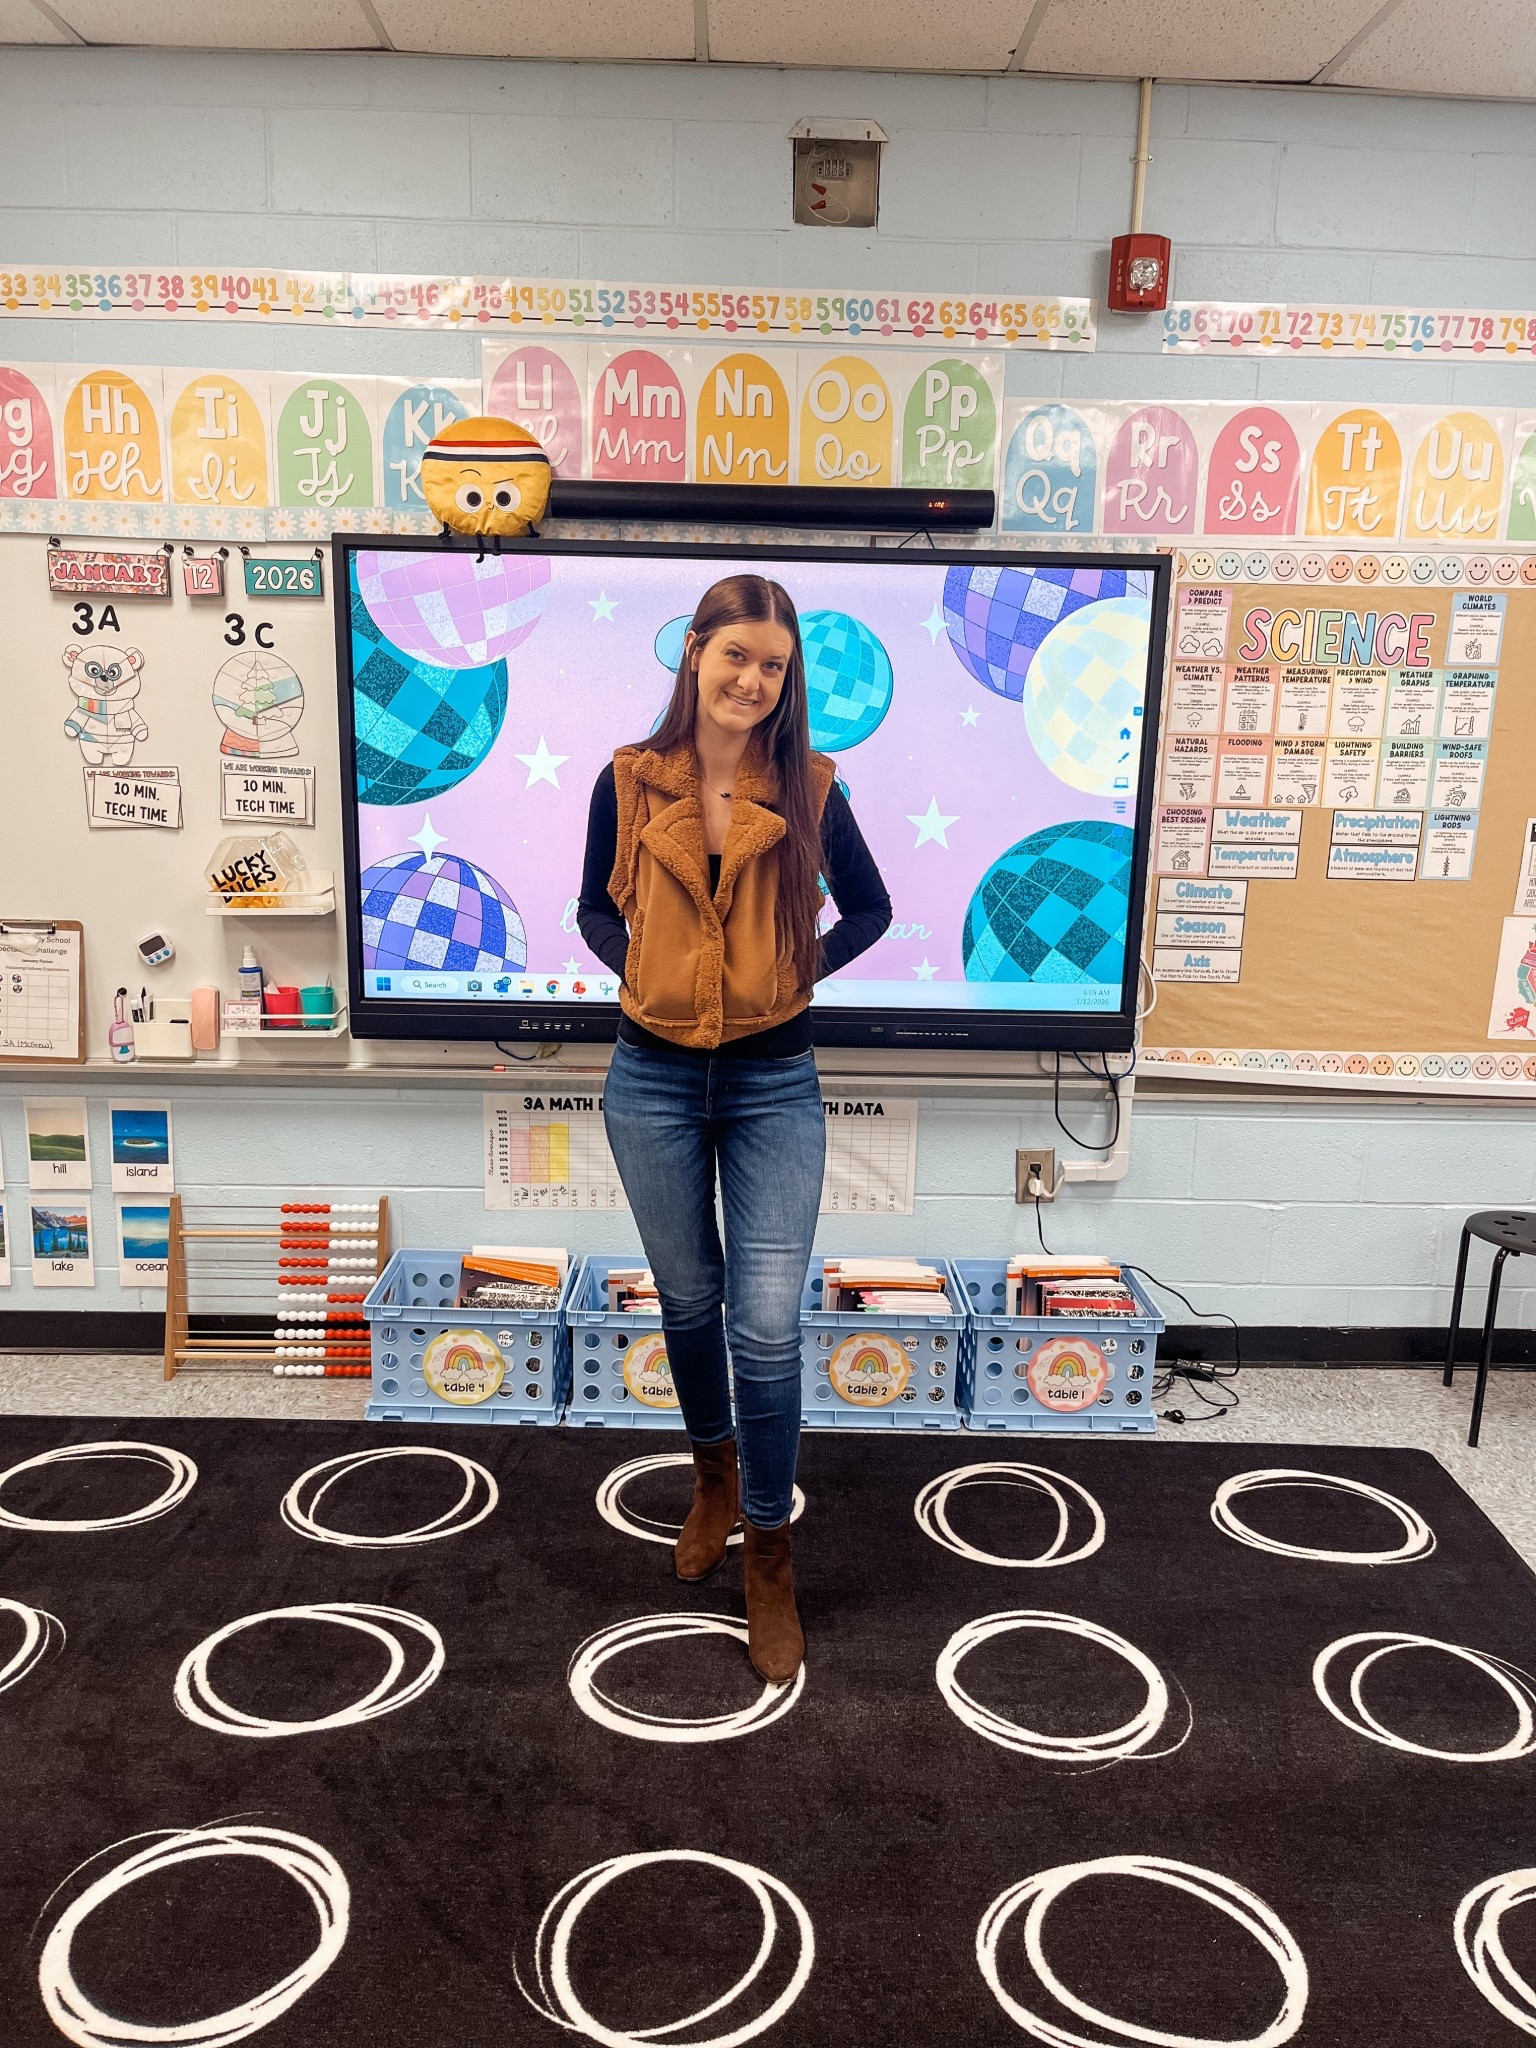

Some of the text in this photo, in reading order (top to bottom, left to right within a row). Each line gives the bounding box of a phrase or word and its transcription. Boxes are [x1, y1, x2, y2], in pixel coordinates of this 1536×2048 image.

[0, 273, 1091, 329] 33 34 35 36 37 38 39 40 41 42 46 49 50 51 52 53 54 55 56 57 58 59 60 61 62 63 64 65 66 67
[1164, 310, 1526, 340] 68 69 70 71 72 73 74 75 76 77 78 79
[516, 361, 553, 410] Ll
[604, 369, 680, 419] Mm
[715, 368, 773, 418] Nn
[808, 369, 886, 423] Oo
[925, 369, 978, 430] Pp
[82, 384, 140, 435] Hh
[195, 387, 239, 439] Ii
[299, 389, 346, 454] Jj
[1025, 416, 1082, 478] Qq
[1130, 421, 1179, 470] Rr
[1235, 426, 1281, 473] Ss
[1337, 423, 1382, 472] Tt
[1428, 430, 1493, 480] Uu
[54, 562, 162, 585] JANUARY
[191, 564, 214, 589] 12
[252, 565, 315, 590] 2026
[1239, 609, 1434, 667] SCIENCE
[1282, 676, 1331, 684] TEMPERATURE
[1452, 672, 1489, 680] GRAPHING
[114, 781, 160, 801] 10 MIN.
[243, 779, 286, 794] 10 MIN.
[104, 801, 168, 823] TECH TIME
[236, 799, 296, 814] TECH TIME
[1166, 808, 1203, 816] CHOOSING
[1180, 816, 1206, 824] DESIGN
[1225, 810, 1290, 828] Weather
[1335, 813, 1420, 832] Precipitation
[1434, 814, 1471, 822] LIGHTNING
[1214, 846, 1295, 864] Temperature
[1333, 848, 1414, 866] Atmosphere
[211, 849, 267, 888] LUCKY
[220, 864, 277, 904] DUCKS
[1176, 882, 1233, 899] Climate
[1174, 917, 1226, 933] Season
[47, 936, 70, 944] School
[1184, 954, 1211, 968] Axis
[424, 981, 447, 989] Search
[1509, 1014, 1528, 1025] ALASKA
[523, 1097, 593, 1110] 3A MATH
[844, 1102, 885, 1116] DATA
[53, 1163, 67, 1174] hill
[126, 1166, 158, 1177] island
[52, 1261, 74, 1272] lake
[136, 1263, 168, 1272] ocean
[444, 1382, 484, 1394] table 4
[642, 1386, 673, 1396] table
[846, 1382, 888, 1396] table 2
[1048, 1388, 1085, 1400] table 1
